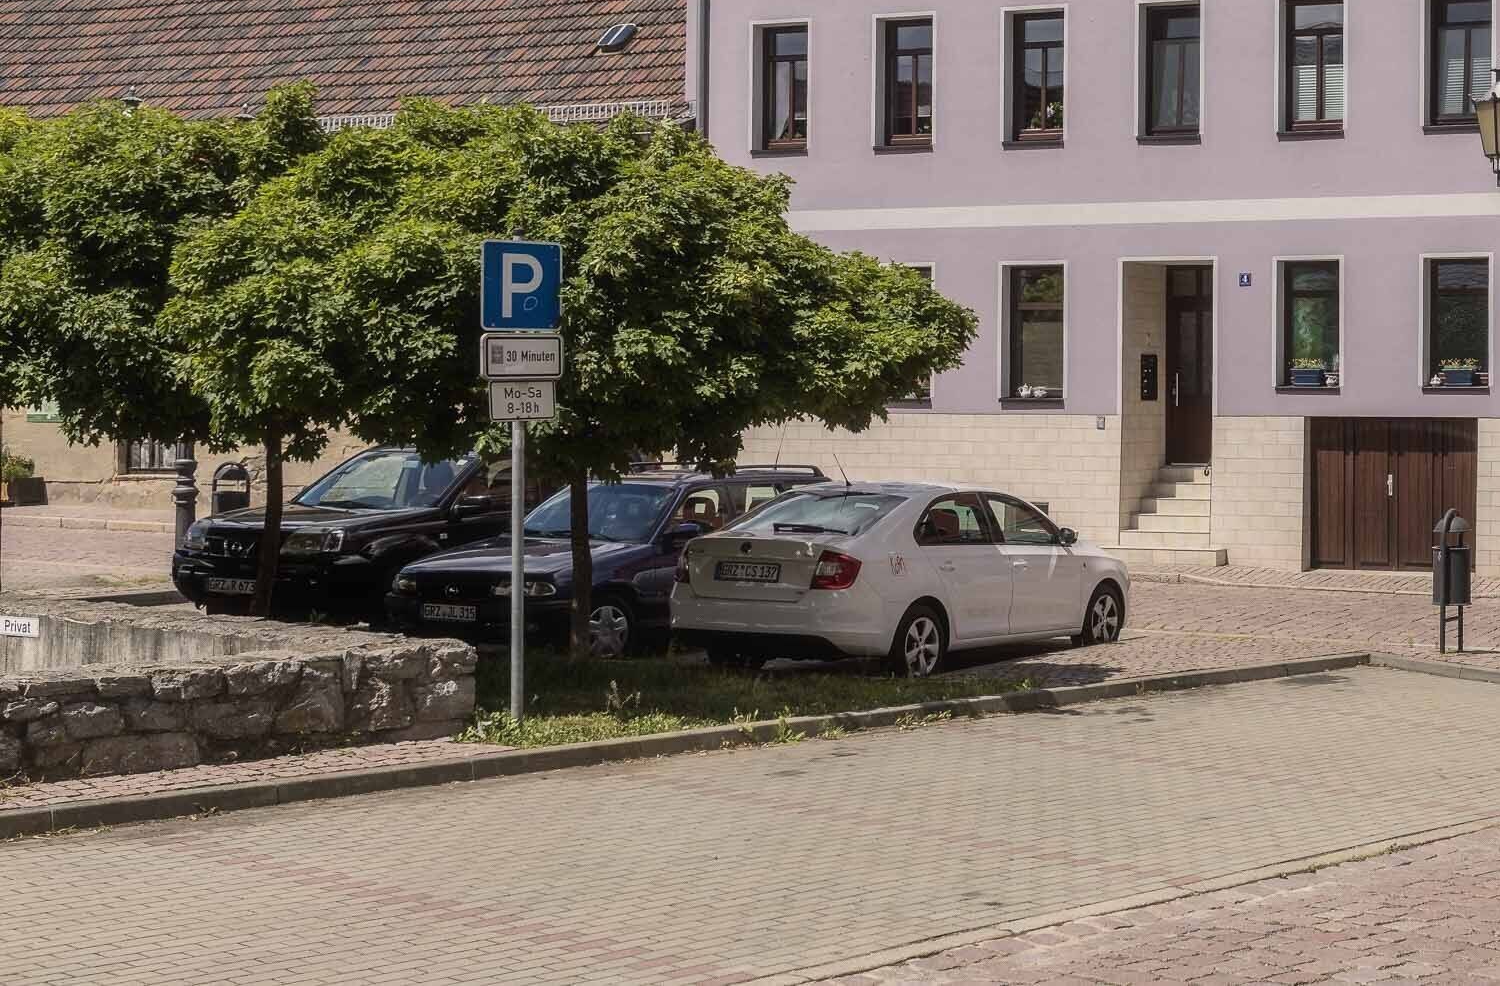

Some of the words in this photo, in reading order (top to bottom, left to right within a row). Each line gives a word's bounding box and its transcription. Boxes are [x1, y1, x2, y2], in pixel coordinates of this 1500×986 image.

[501, 252, 545, 319] P
[506, 351, 518, 363] 30
[521, 350, 556, 363] Minuten
[503, 387, 543, 400] Mo-Sa
[4, 619, 31, 633] Privat
